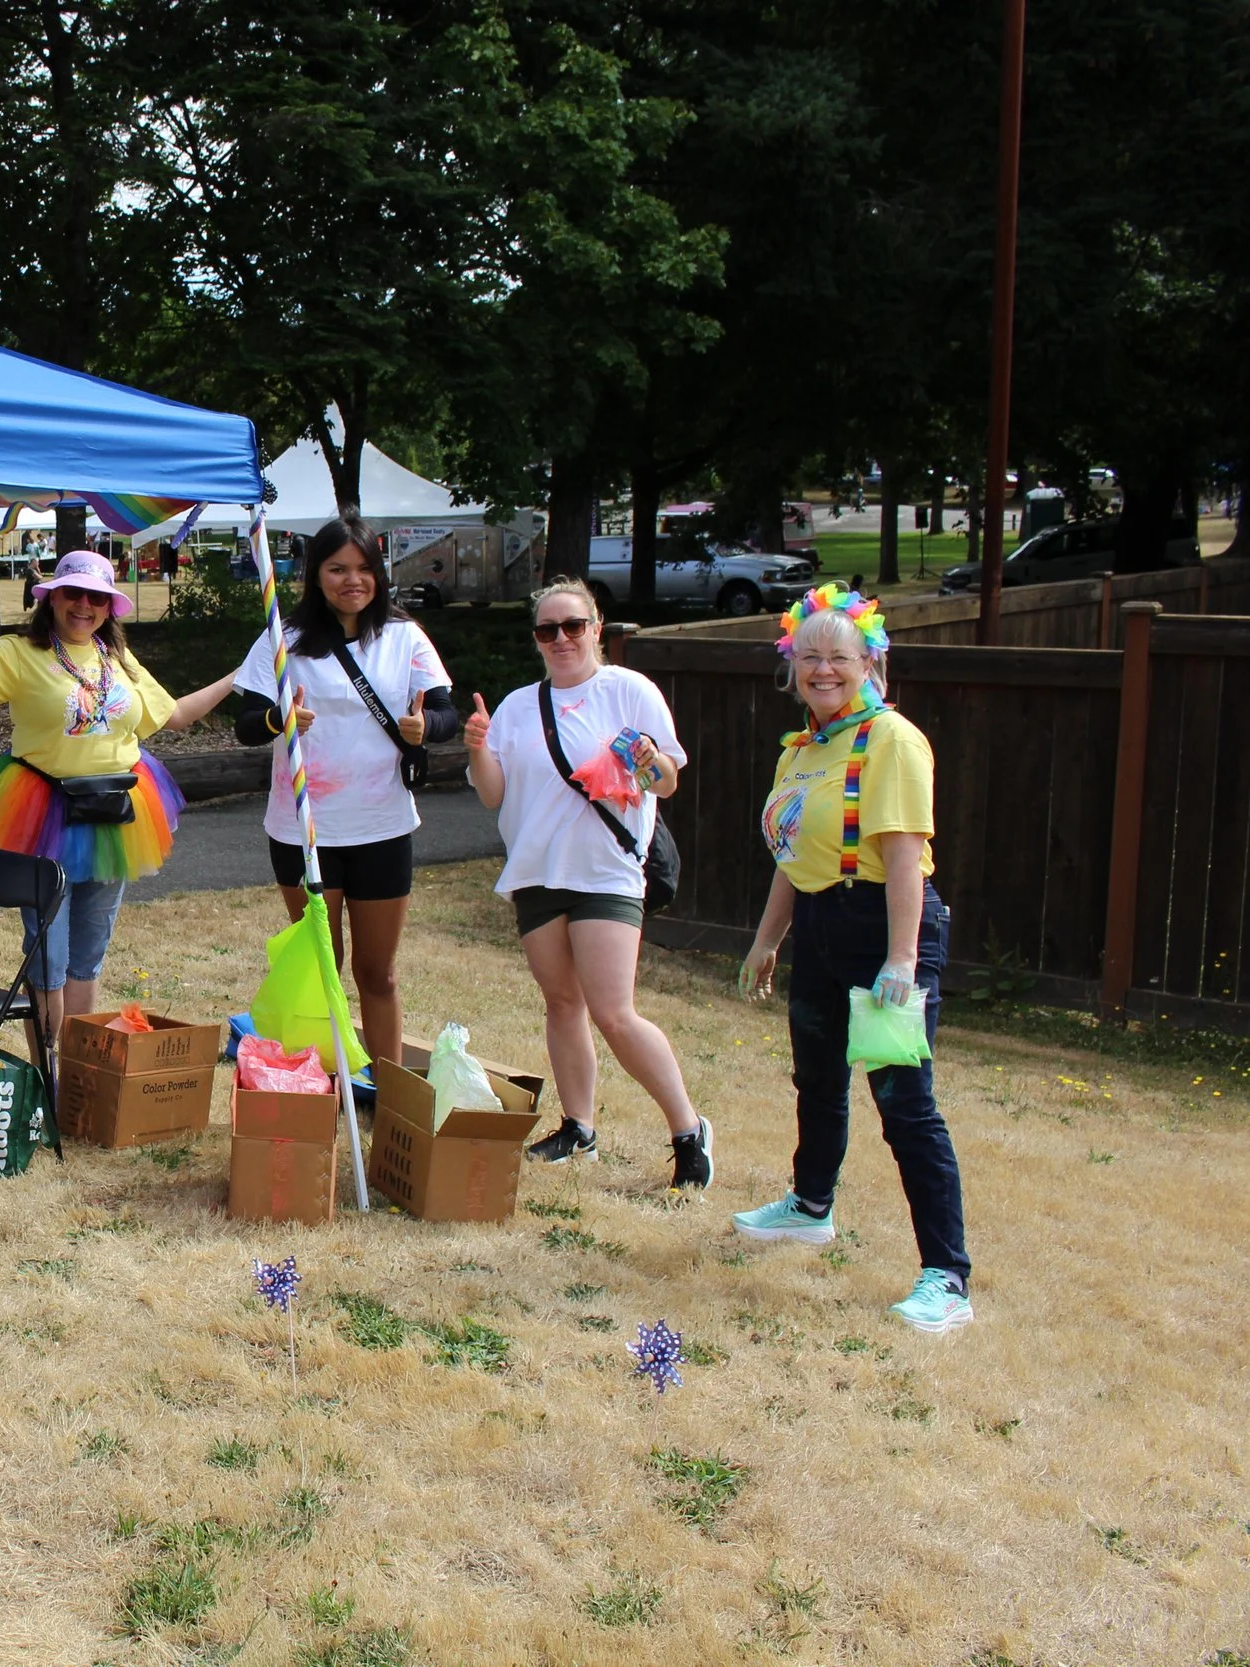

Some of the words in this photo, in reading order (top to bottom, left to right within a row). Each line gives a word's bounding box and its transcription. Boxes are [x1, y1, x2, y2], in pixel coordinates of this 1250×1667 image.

[353, 675, 388, 727] lululemon
[142, 1082, 166, 1094] Color
[167, 1079, 198, 1092] Powder
